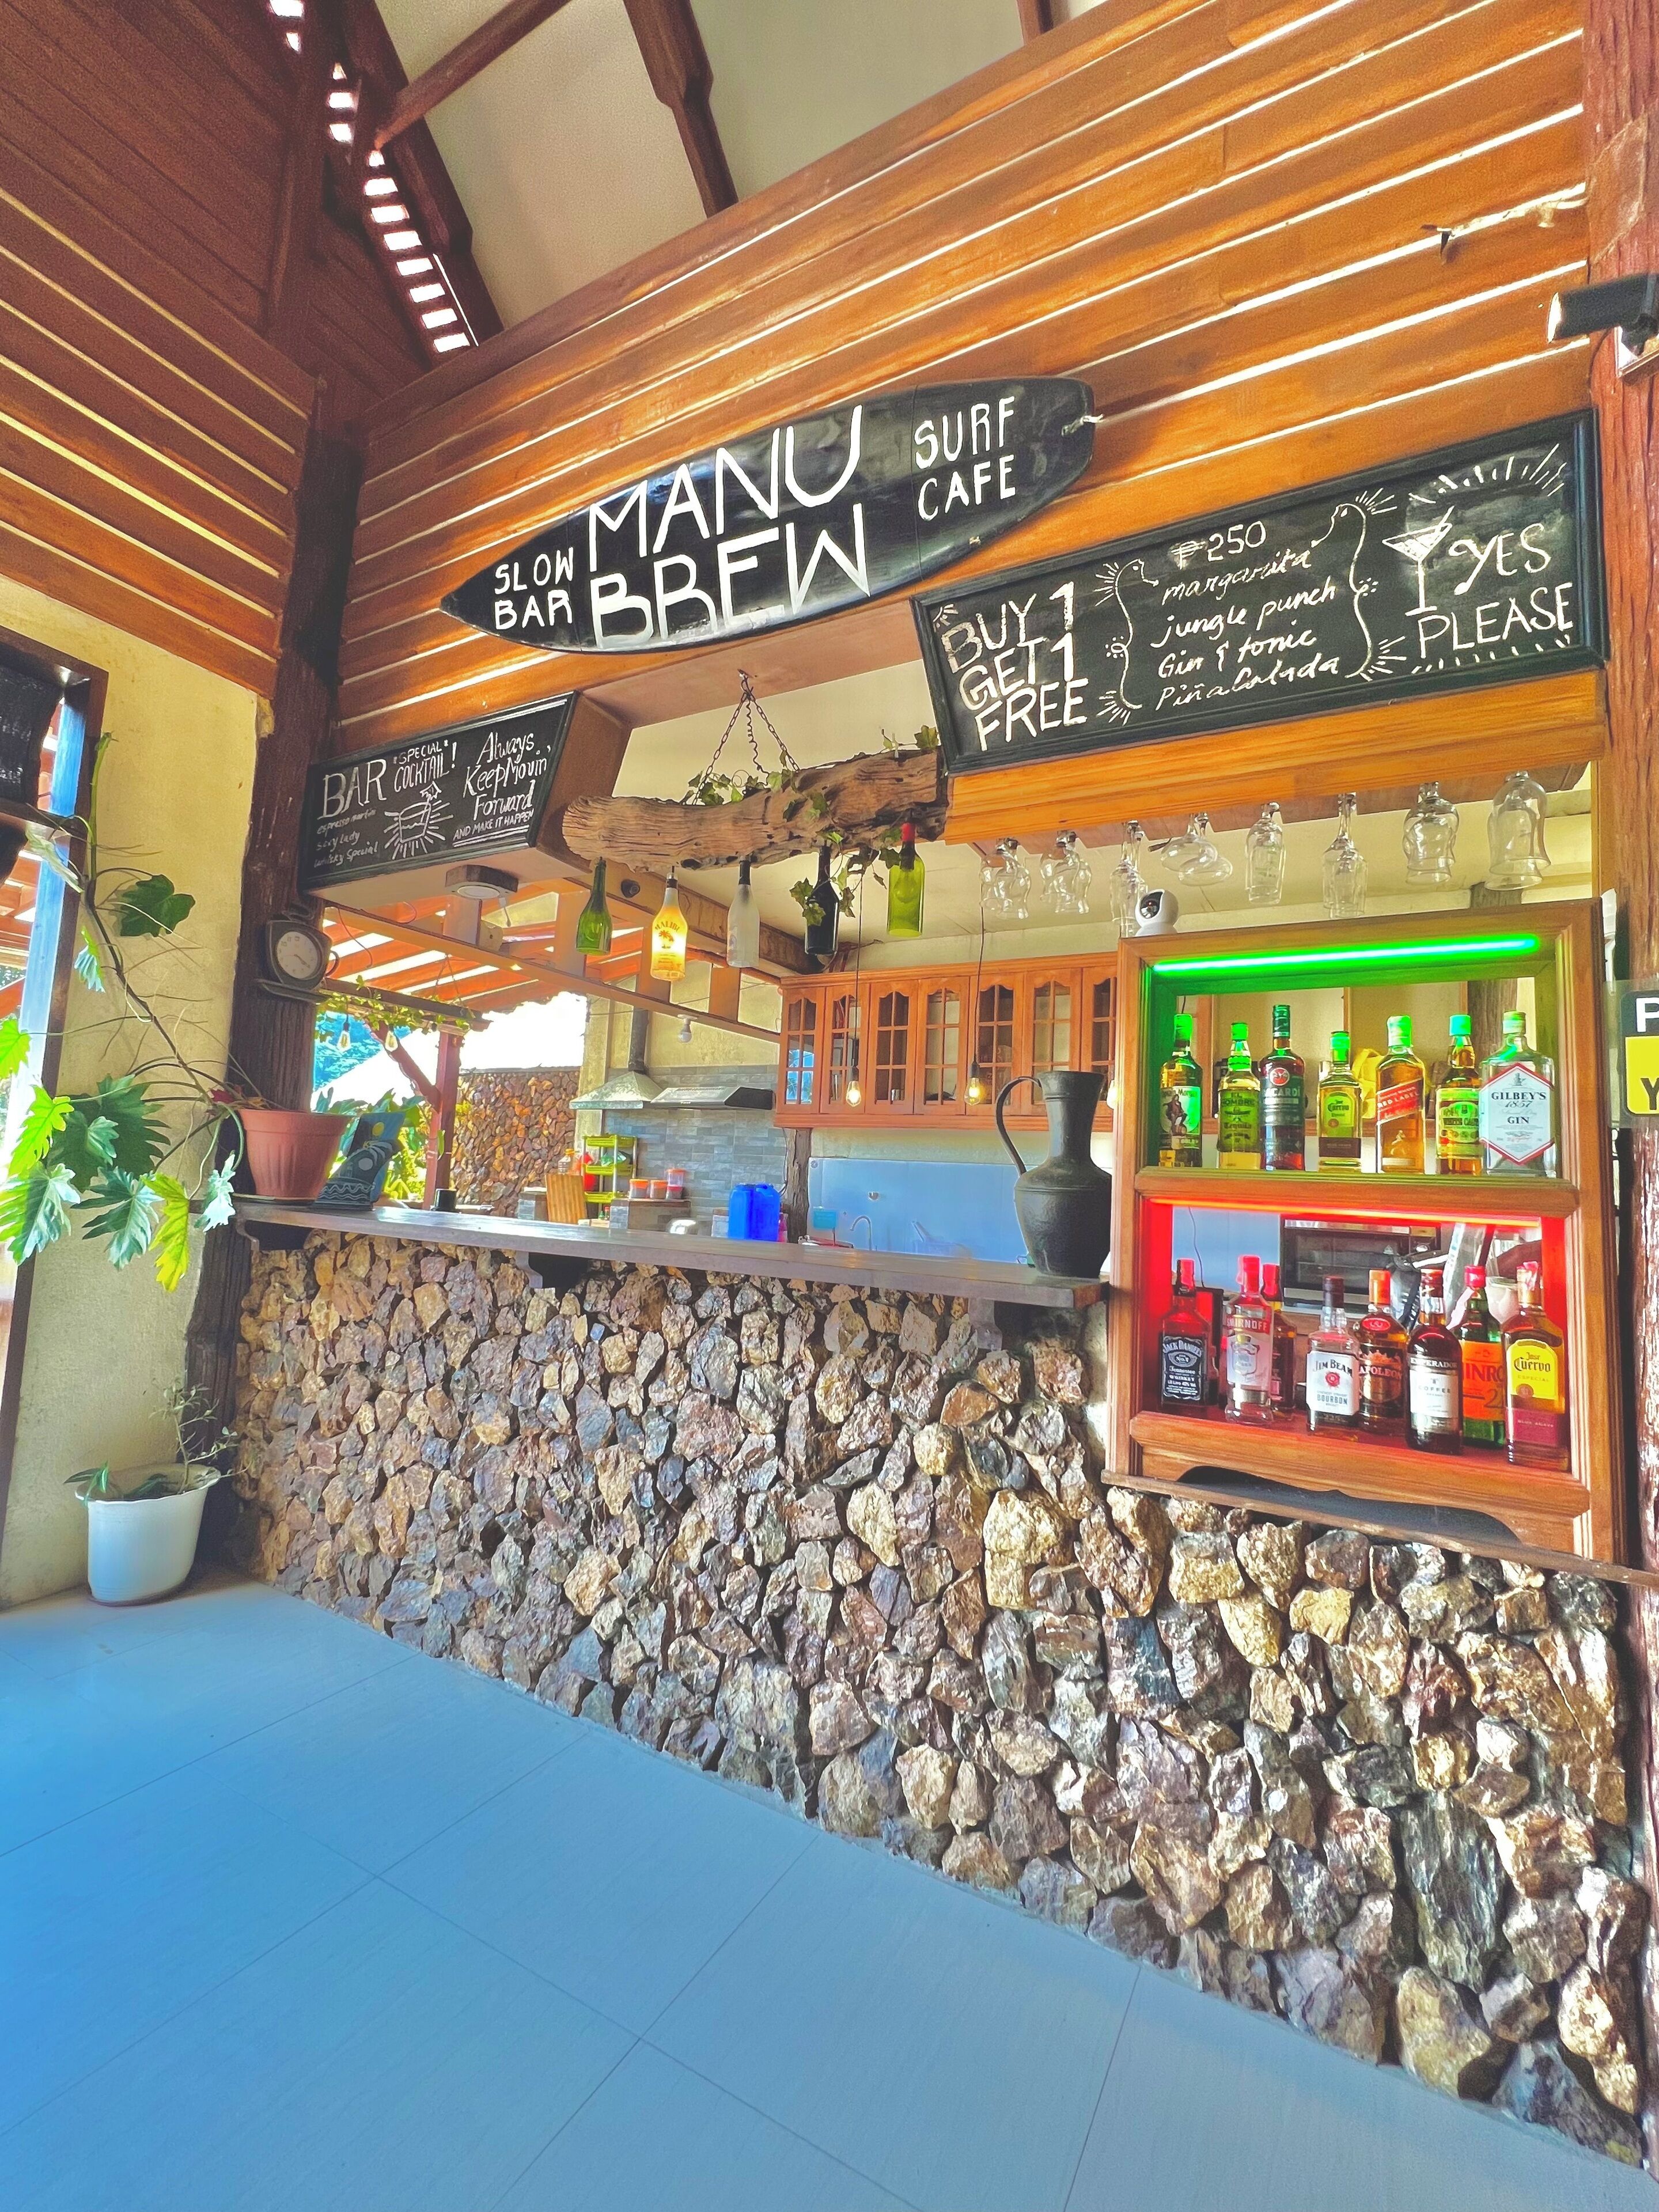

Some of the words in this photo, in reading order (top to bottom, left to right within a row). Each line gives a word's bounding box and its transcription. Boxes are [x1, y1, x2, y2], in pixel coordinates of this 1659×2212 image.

[914, 396, 1015, 469] SURF
[589, 404, 862, 572] MANU
[918, 454, 1016, 521] CAFE
[495, 546, 573, 594] SLOW
[590, 503, 870, 649] BREW
[1162, 548, 1312, 605] margarita
[1449, 522, 1551, 596] YES
[495, 589, 573, 630] BAR
[941, 593, 1037, 674] BUY
[1049, 581, 1075, 632] 1
[1150, 605, 1248, 649] jungle
[1256, 576, 1336, 631] punch
[1418, 582, 1573, 658] PLEASE
[959, 635, 1050, 711] GET
[1051, 632, 1075, 682] 1
[1158, 650, 1204, 679] Gin
[1237, 620, 1317, 664] tonic
[1156, 683, 1230, 711] Piña
[1232, 652, 1340, 692] Colada
[975, 679, 1089, 752] FREE
[476, 732, 534, 765] Always
[317, 759, 388, 820] BAR
[463, 763, 506, 798] Keep
[474, 779, 536, 821] Forward
[339, 831, 360, 846] lady
[453, 825, 471, 840] AND
[472, 818, 494, 835] MAKE
[495, 816, 504, 828] IT
[503, 808, 535, 826] HAPPEN
[1377, 1099, 1393, 1108] RED
[1394, 1090, 1419, 1103] LABEL
[1491, 1092, 1547, 1100] GILBEY'S
[1507, 1116, 1530, 1124] GIN
[1162, 1341, 1179, 1354] JACK
[1312, 1360, 1328, 1372] JIM
[1330, 1359, 1353, 1378] BEAM
[1514, 1357, 1551, 1373] Cuervo
[1359, 1365, 1403, 1379] APOLEON
[1418, 1385, 1451, 1393] COFFEE
[1317, 1394, 1348, 1405] BOURBON
